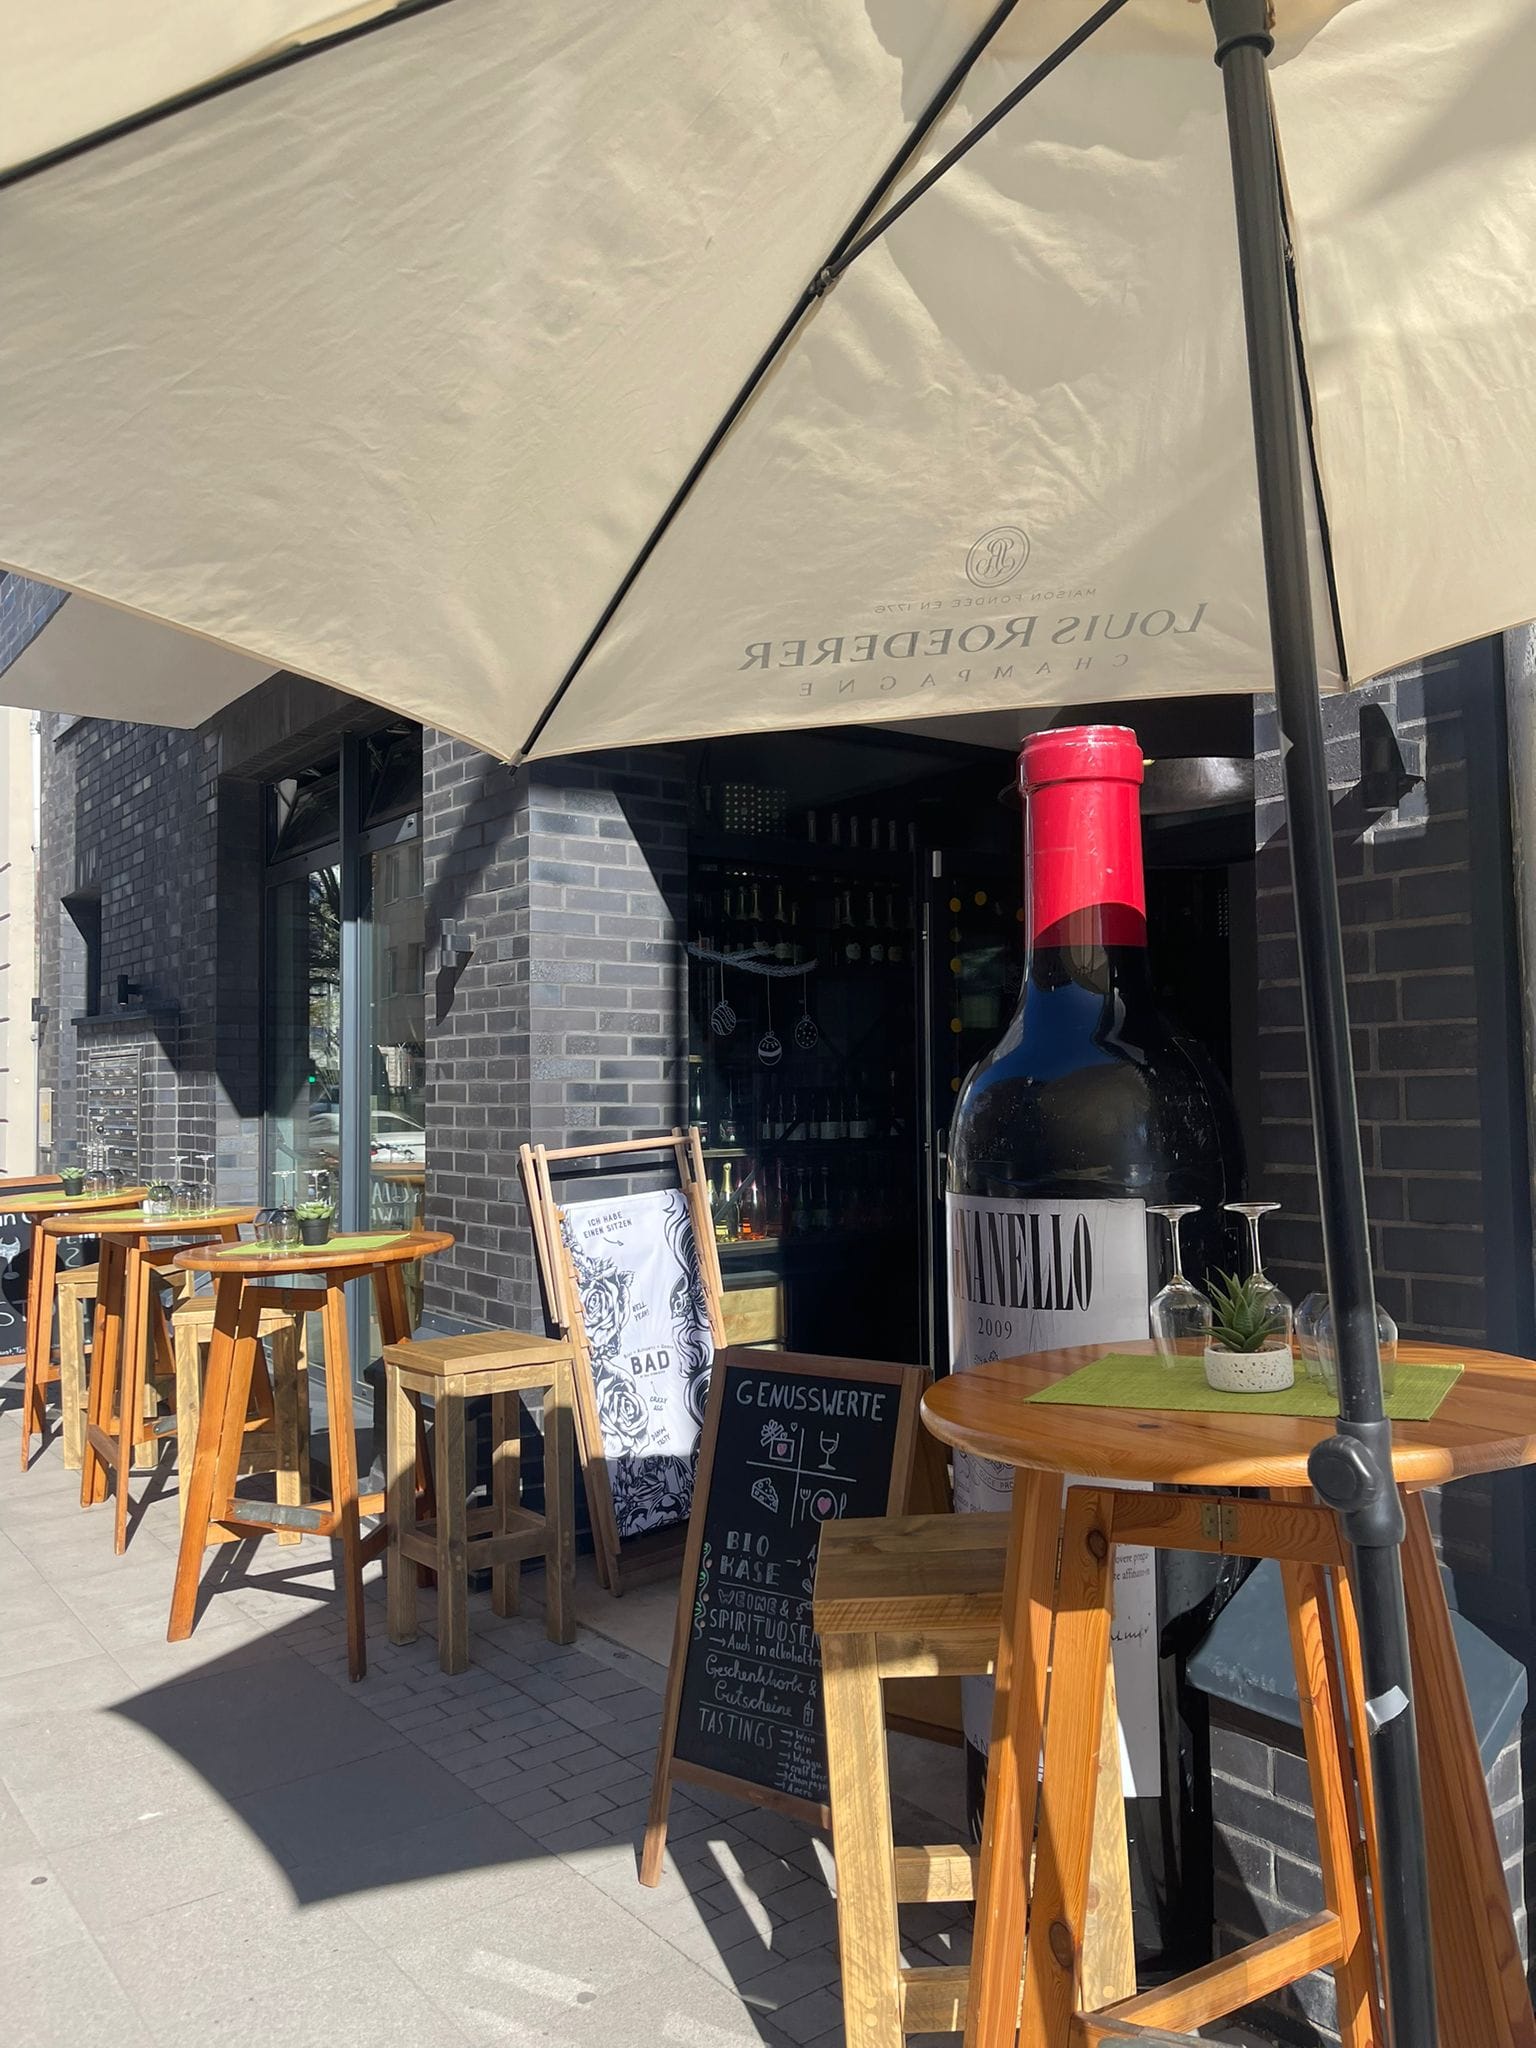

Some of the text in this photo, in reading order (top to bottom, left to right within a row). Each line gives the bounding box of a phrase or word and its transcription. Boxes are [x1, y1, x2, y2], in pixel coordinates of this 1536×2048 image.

[587, 1217, 601, 1227] ICH
[606, 1218, 632, 1232] SITZEN
[977, 1316, 1013, 1340] 2009
[630, 1350, 670, 1375] BAD
[735, 1379, 887, 1422] GENUSSWERTE
[726, 1530, 770, 1557] BIO
[779, 1599, 790, 1620] &
[714, 1679, 793, 1718] Gutscheine
[808, 1679, 818, 1698] &
[699, 1707, 775, 1750] TASTINGS
[793, 1740, 812, 1755] Gin
